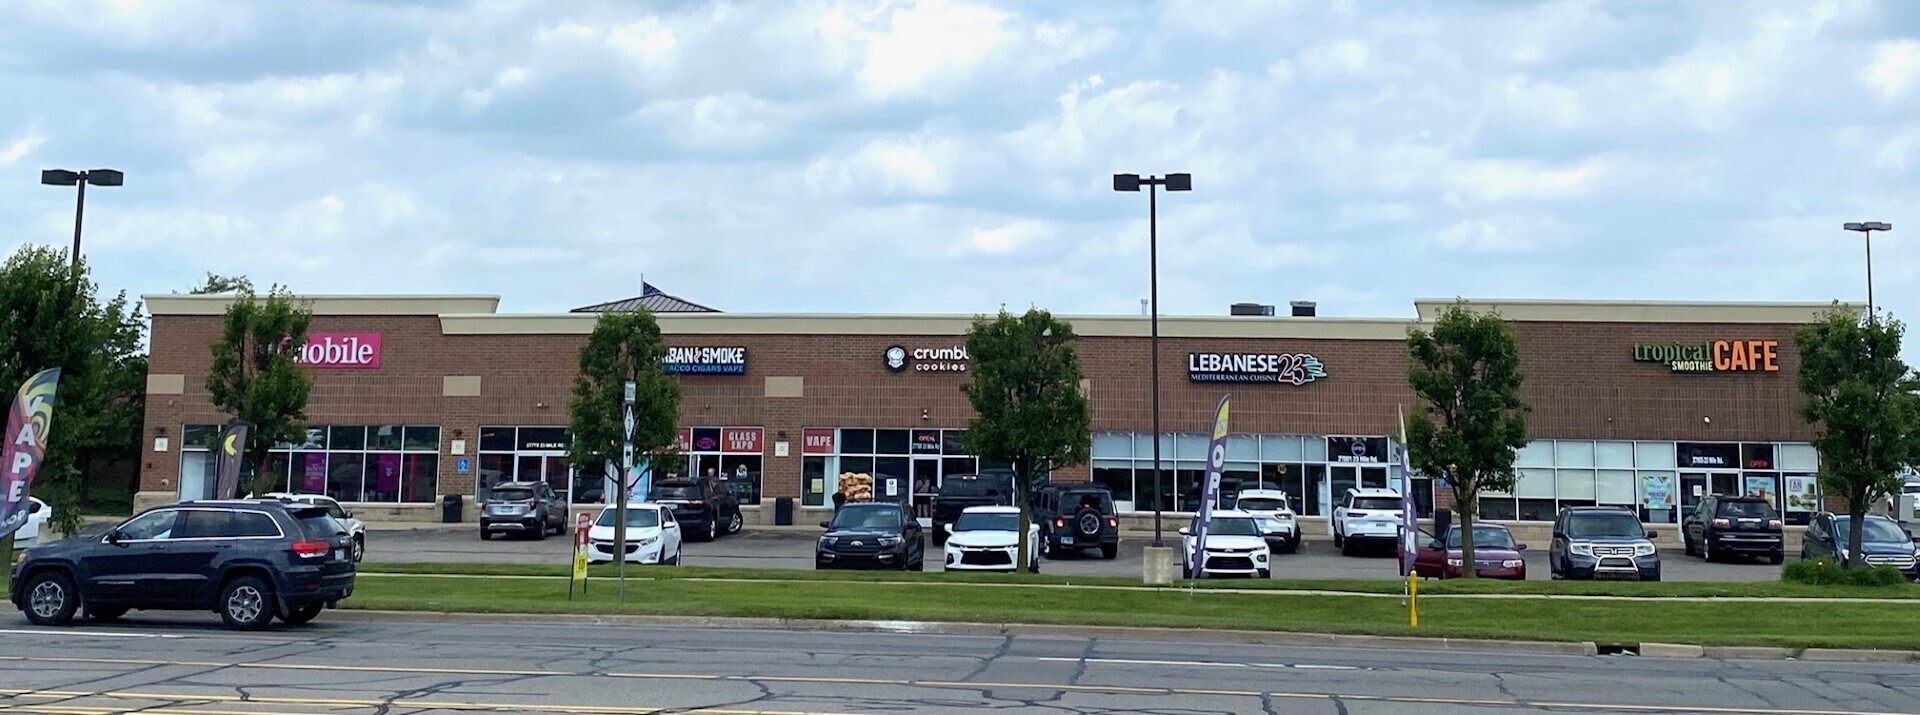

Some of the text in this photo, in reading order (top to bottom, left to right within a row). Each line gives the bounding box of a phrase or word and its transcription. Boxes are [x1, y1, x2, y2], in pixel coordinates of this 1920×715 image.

[702, 347, 745, 364] SMOKE
[913, 345, 970, 360] crumbl
[1633, 340, 1779, 371] tropical CAFE
[692, 364, 721, 372] CIGARS
[722, 364, 744, 373] VAPE
[915, 362, 966, 371] cookies
[1189, 353, 1305, 386] LEBANESE 23
[1671, 360, 1714, 371] SMOOTHIE
[1190, 373, 1249, 381] MEDITERRANEAN
[728, 431, 757, 441] GLASS
[806, 435, 832, 447] VAPE
[8, 394, 44, 503] VAPE
[731, 441, 754, 450] EXPO
[1750, 459, 1768, 468] OPEN
